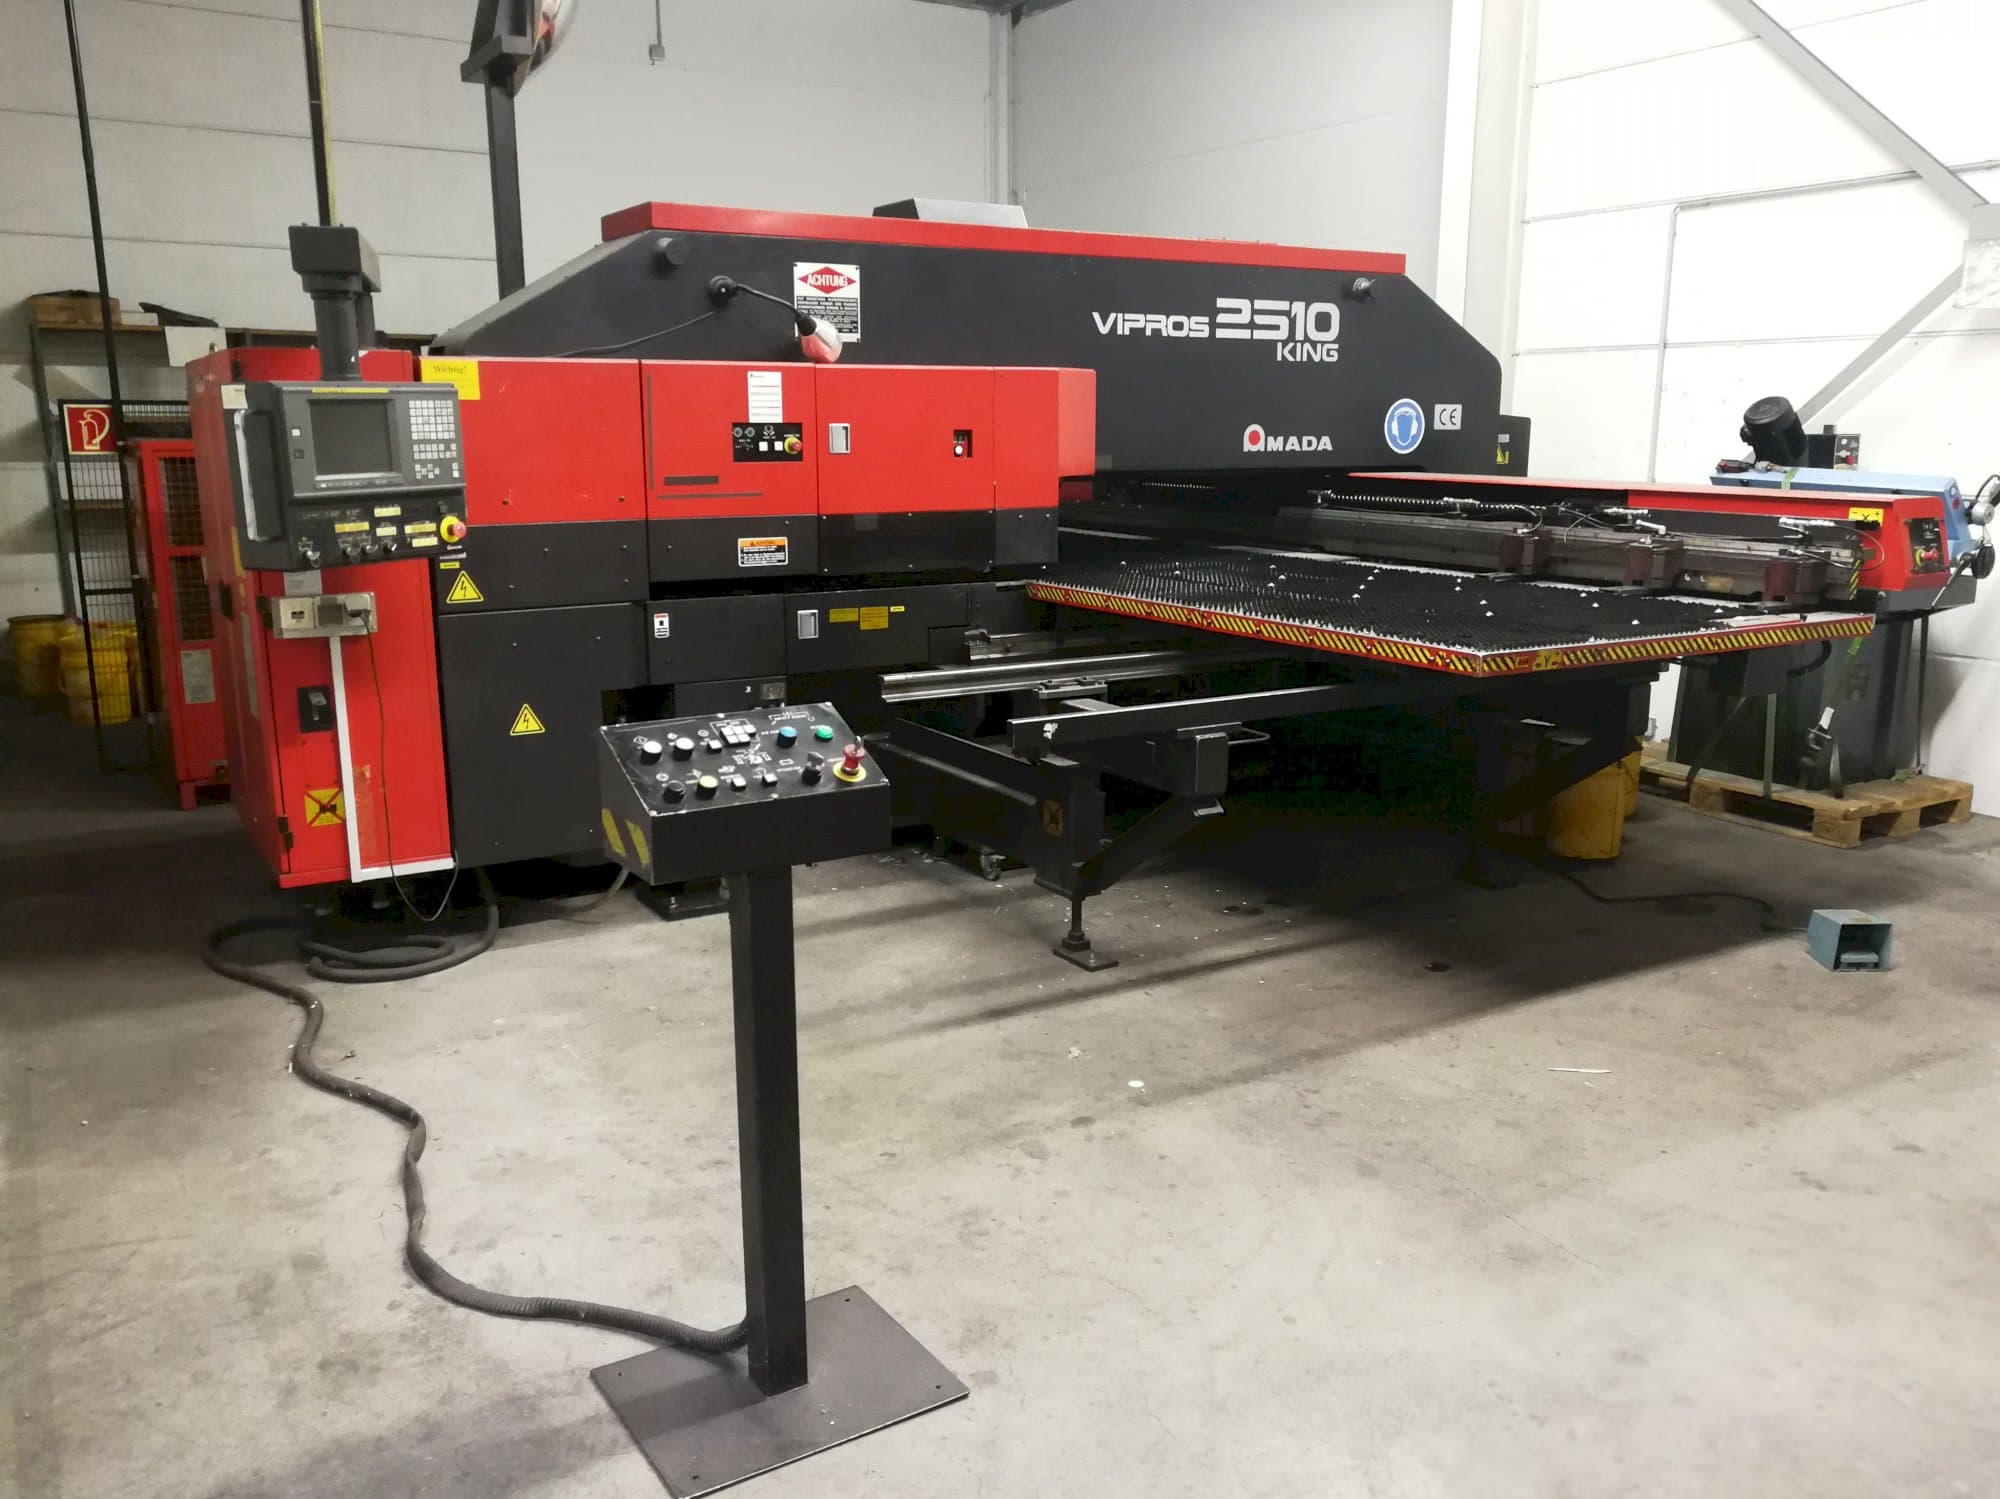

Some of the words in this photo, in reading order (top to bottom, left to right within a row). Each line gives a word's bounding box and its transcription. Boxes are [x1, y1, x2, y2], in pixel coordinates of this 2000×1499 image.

[807, 273, 849, 288] ACHTUNG
[1092, 312, 1210, 338] VIPROS
[1215, 297, 1340, 341] 2510
[1276, 342, 1339, 362] KING
[1243, 424, 1334, 452] AMADA
